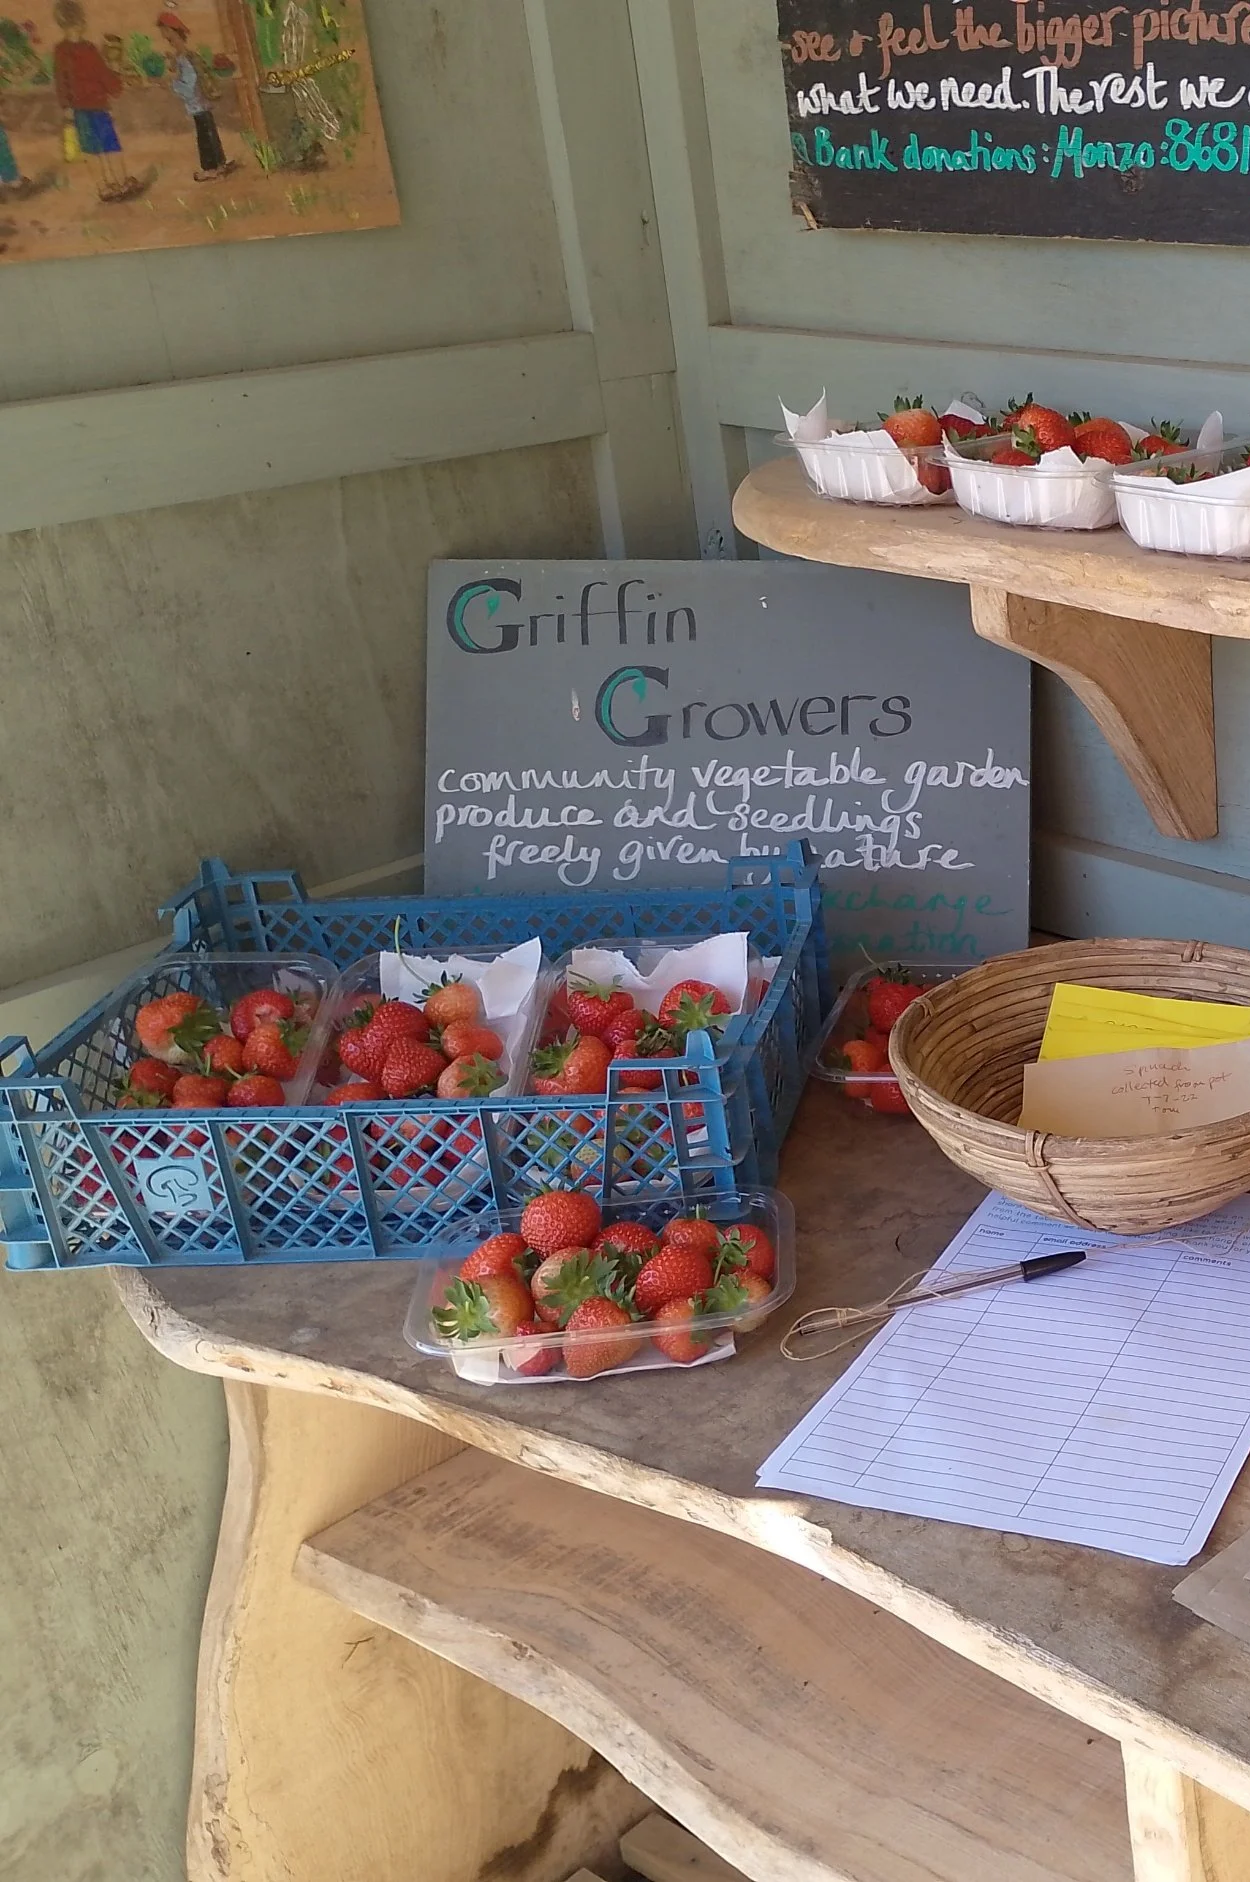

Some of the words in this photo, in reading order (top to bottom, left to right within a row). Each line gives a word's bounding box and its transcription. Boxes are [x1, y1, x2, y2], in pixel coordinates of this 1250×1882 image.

[791, 30, 842, 63] see
[878, 3, 950, 80] feel
[951, 6, 1014, 52] the
[1016, 1, 1129, 69] bigger
[798, 72, 880, 117] what
[887, 78, 937, 111] we
[941, 66, 1030, 111] need.
[1023, 65, 1094, 115] The
[1089, 62, 1168, 113] rest
[1180, 75, 1246, 111] we
[814, 126, 898, 172] Bank
[447, 577, 698, 655] Griffin
[595, 665, 912, 747] Growers
[438, 755, 674, 795] community
[691, 746, 886, 815] vegetable
[882, 748, 1030, 813] garden
[435, 794, 603, 844] produce
[613, 791, 716, 831] and
[728, 795, 923, 848] seedlings
[483, 834, 602, 886] freely
[613, 838, 729, 881] given
[821, 833, 976, 873] ature
[1111, 1077, 1168, 1095] collected
[979, 1228, 1006, 1238] name
[1042, 1235, 1069, 1246] email
[1069, 1238, 1107, 1250] address
[1182, 1254, 1233, 1268] comments
